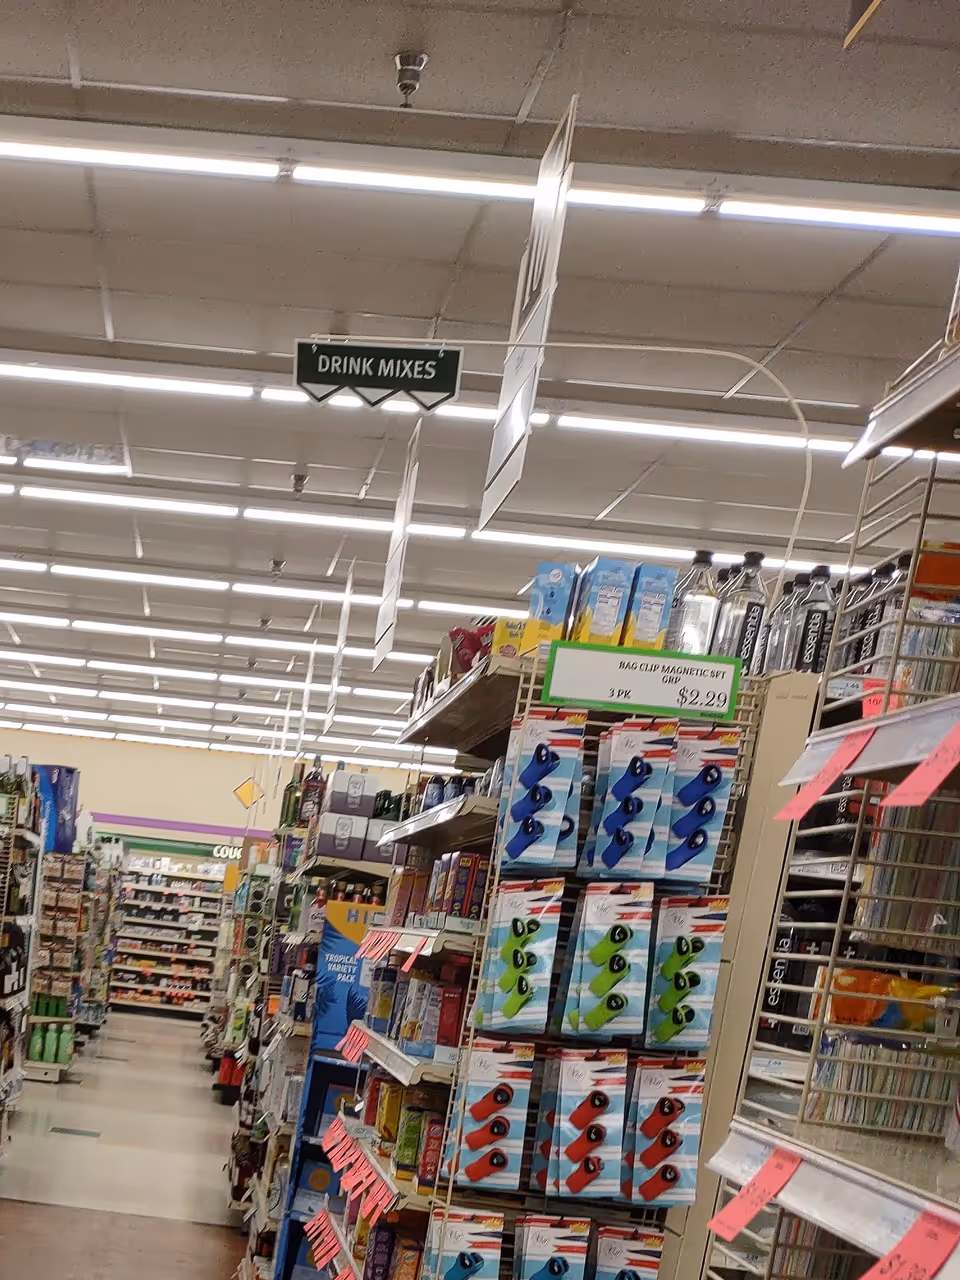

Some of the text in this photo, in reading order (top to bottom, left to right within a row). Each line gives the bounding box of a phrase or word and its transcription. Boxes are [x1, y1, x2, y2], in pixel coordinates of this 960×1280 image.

[317, 354, 437, 380] DRINK MIXES
[740, 604, 761, 660] essentia
[803, 612, 823, 663] essentia
[618, 660, 638, 671] BAG
[639, 663, 661, 673] CLIP
[661, 664, 709, 678] MAGNETIC
[608, 688, 632, 700] 3 PK
[675, 685, 727, 708] $2.29
[325, 953, 358, 965] TROPICAL
[327, 962, 358, 975] VARIETY
[336, 972, 356, 983] PACK
